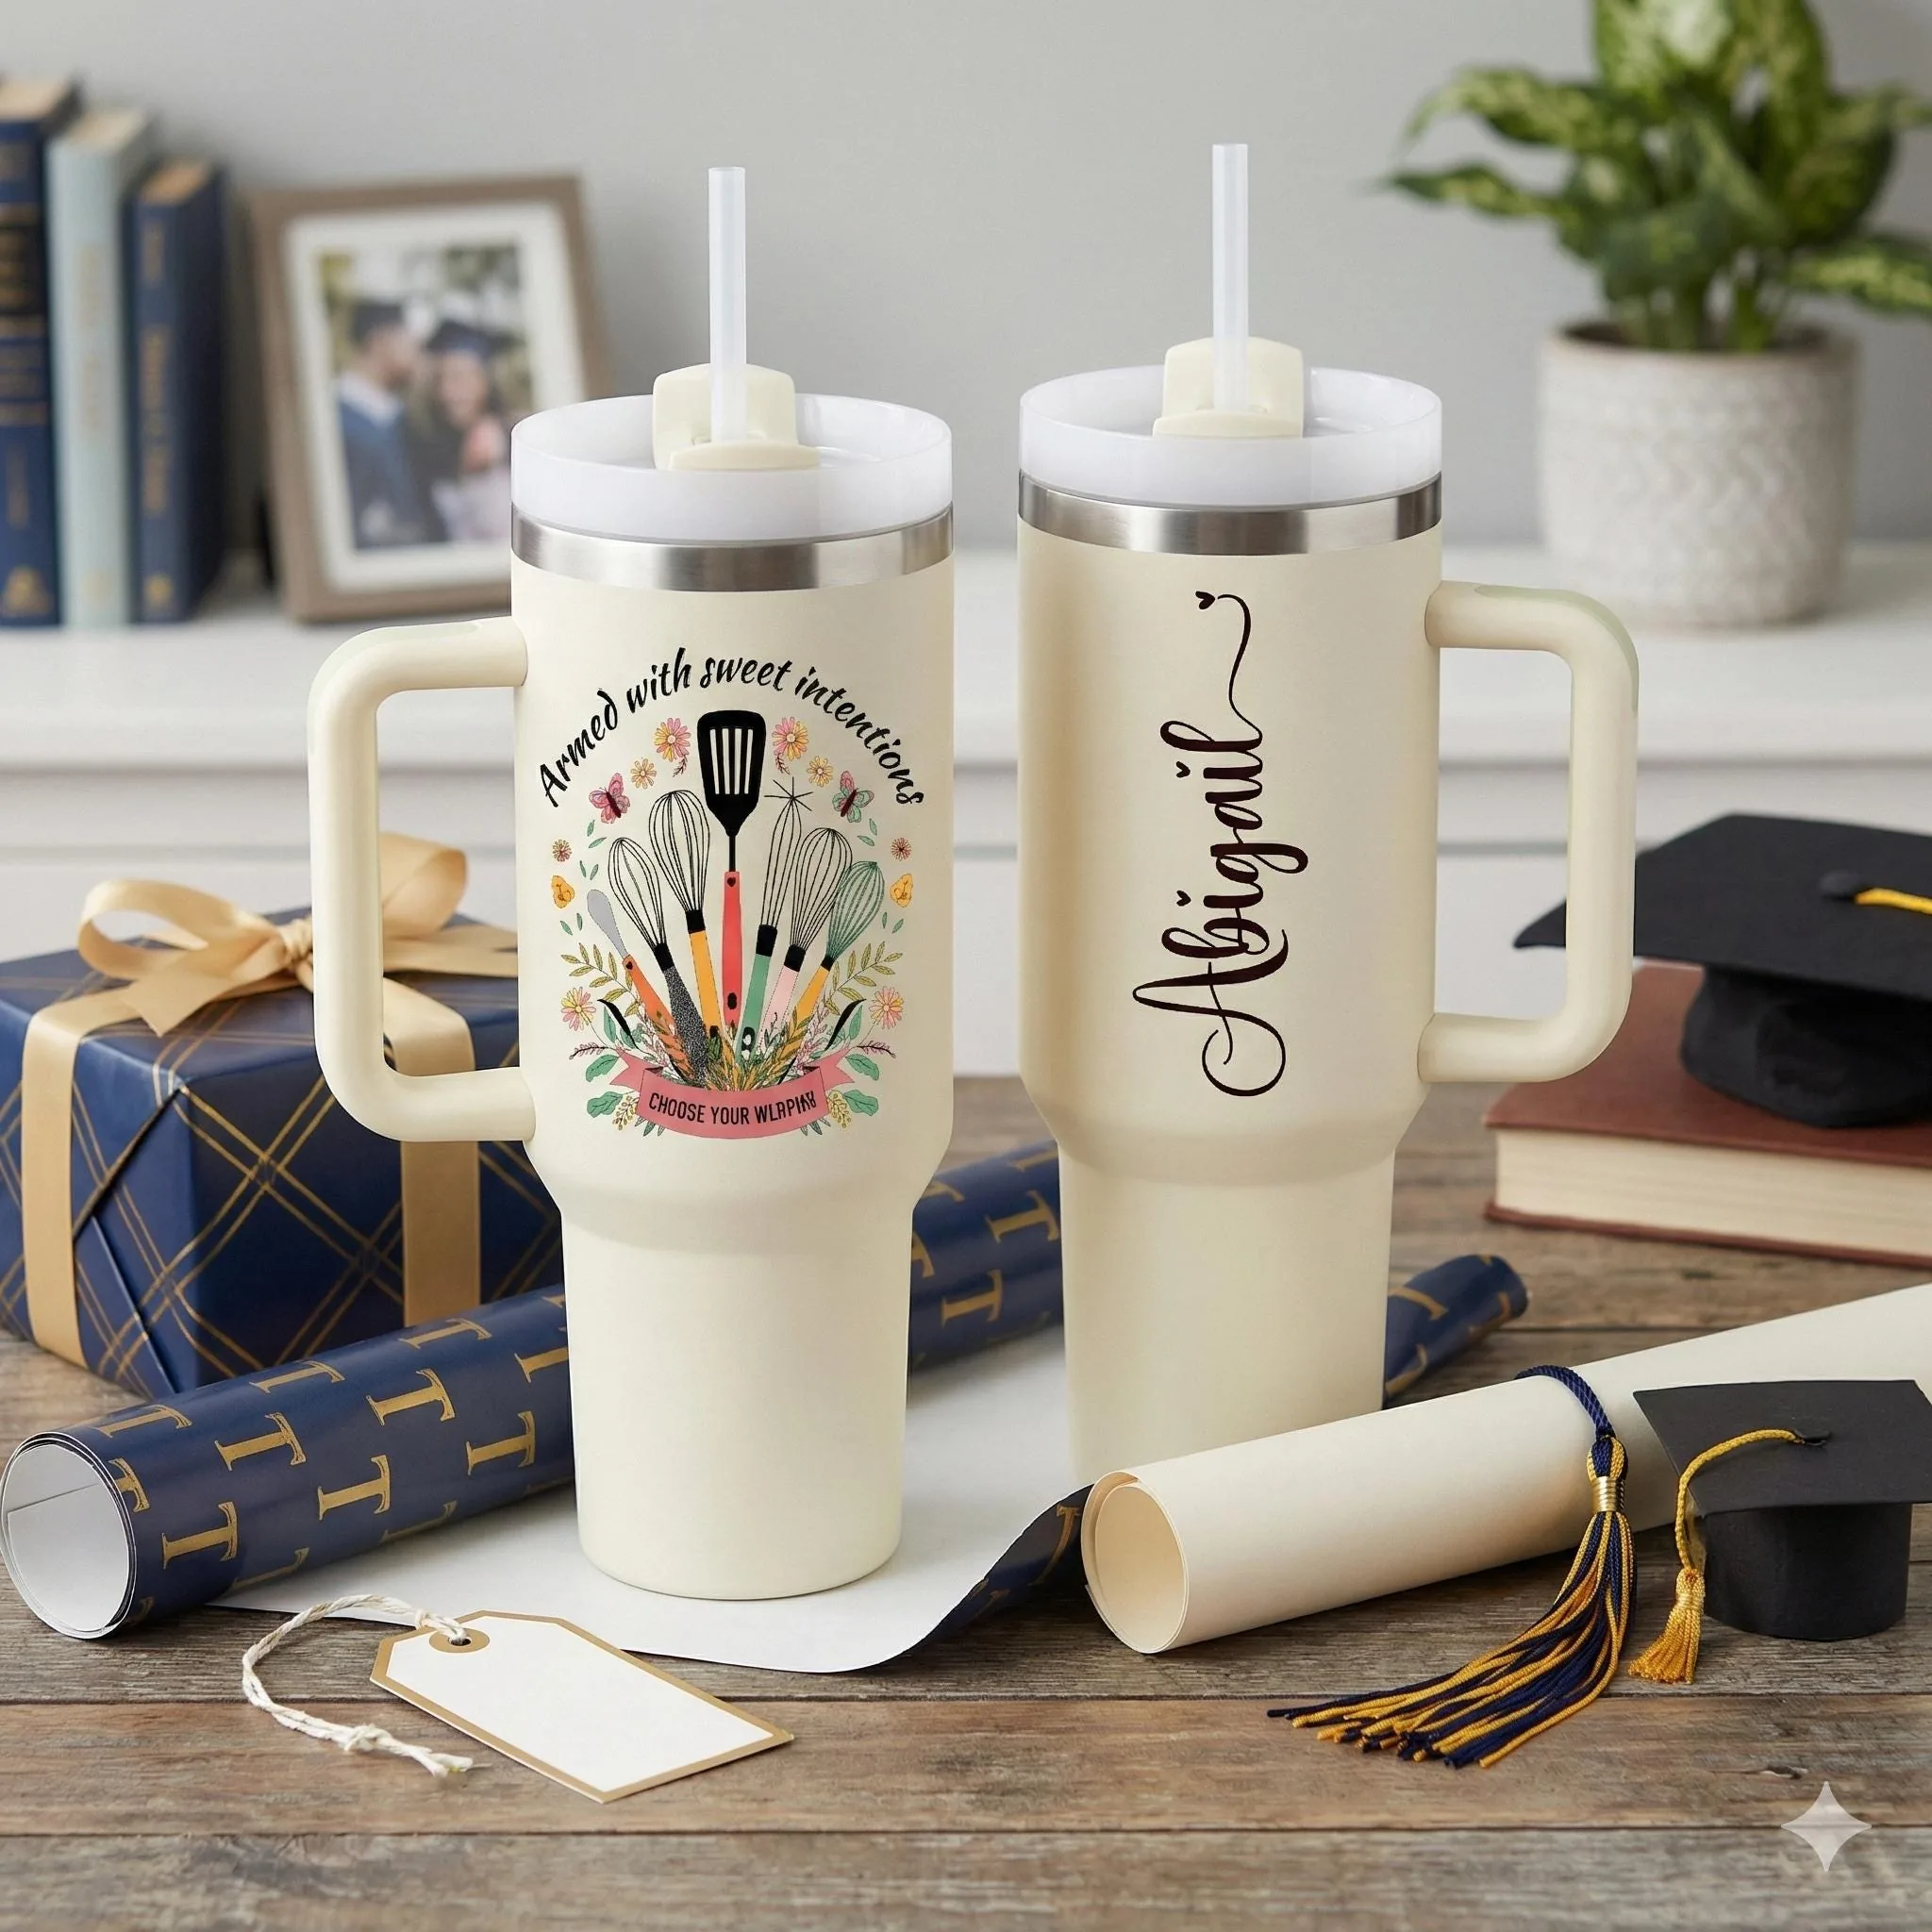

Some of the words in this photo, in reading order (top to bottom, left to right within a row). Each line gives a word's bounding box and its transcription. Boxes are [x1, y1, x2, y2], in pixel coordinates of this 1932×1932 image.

[539, 689, 619, 808] Armed
[625, 647, 692, 713] with
[699, 657, 793, 691] sweet
[794, 666, 924, 806] intentions
[1132, 592, 1309, 1097] Abigail
[648, 1091, 707, 1124] CHOOSE
[710, 1106, 750, 1125] YOUR
